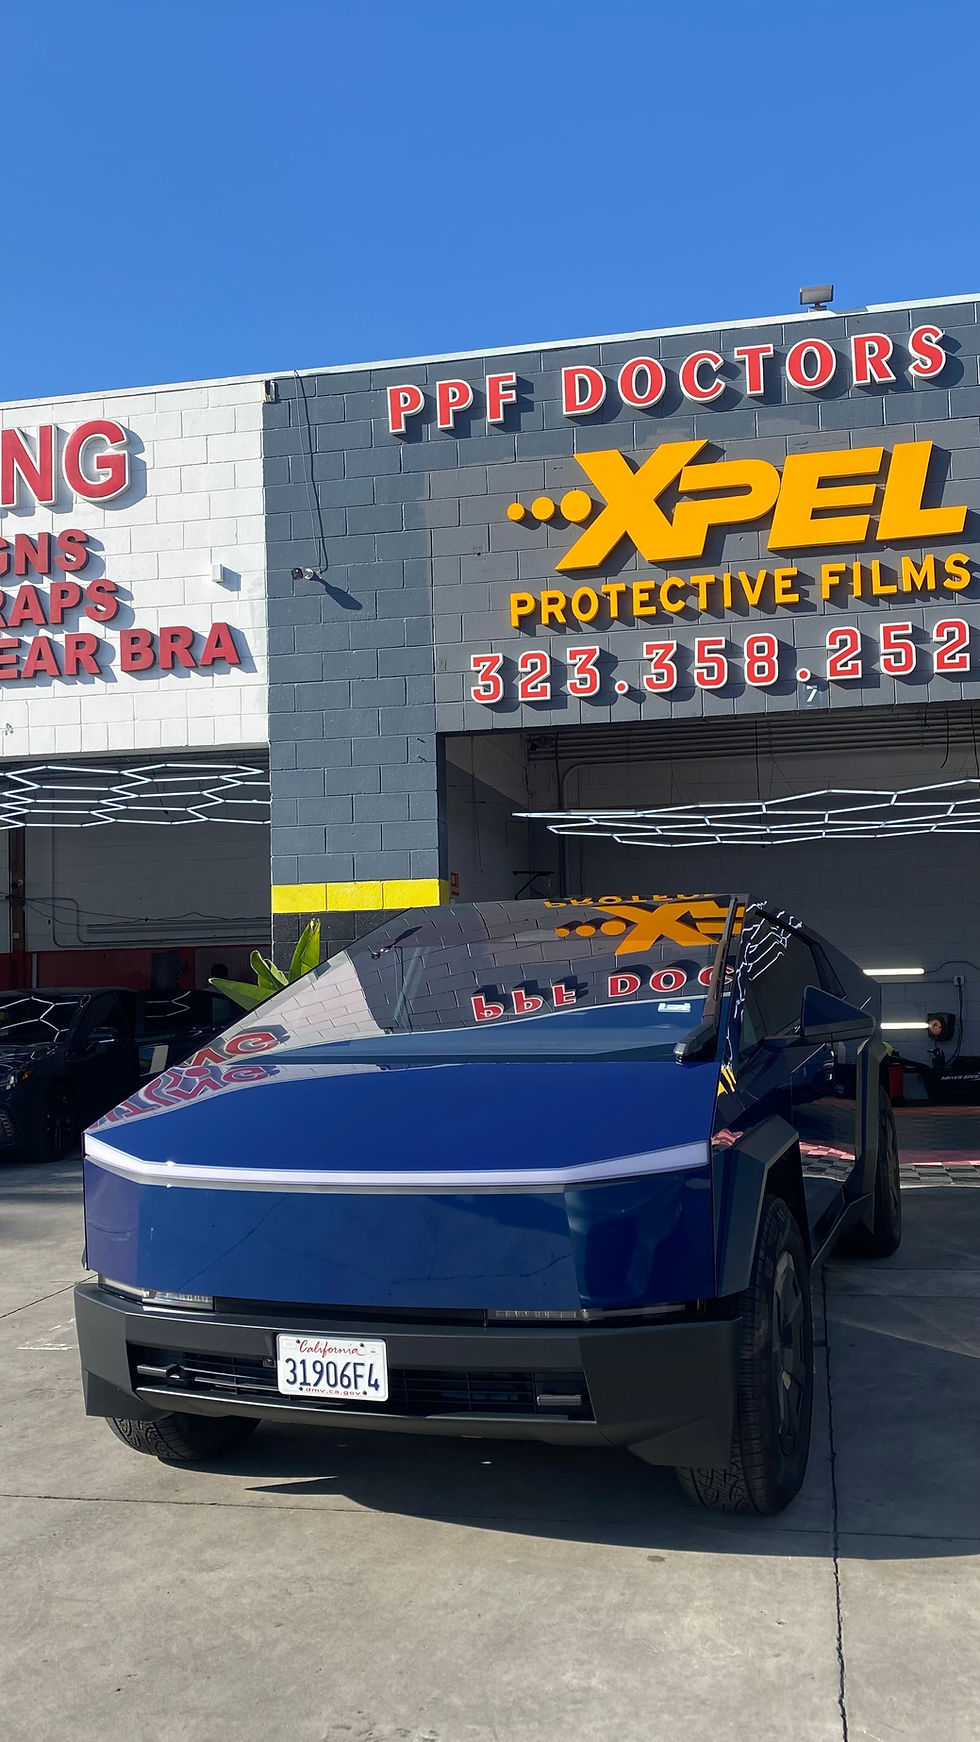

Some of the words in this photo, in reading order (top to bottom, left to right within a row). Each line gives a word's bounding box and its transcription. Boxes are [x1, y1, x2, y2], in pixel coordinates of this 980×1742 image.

[386, 372, 518, 434] PPF
[561, 325, 946, 416] DOCTORS
[555, 439, 968, 571] XPEL
[0, 528, 88, 575] NS
[0, 578, 120, 627] APS
[510, 566, 800, 628] PROTECTIVE
[820, 552, 971, 600] FILMS
[119, 622, 241, 673] BRA
[299, 1339, 366, 1358] California
[285, 1358, 380, 1391] 31906F4
[305, 1387, 361, 1396] dmv.ca.gov
